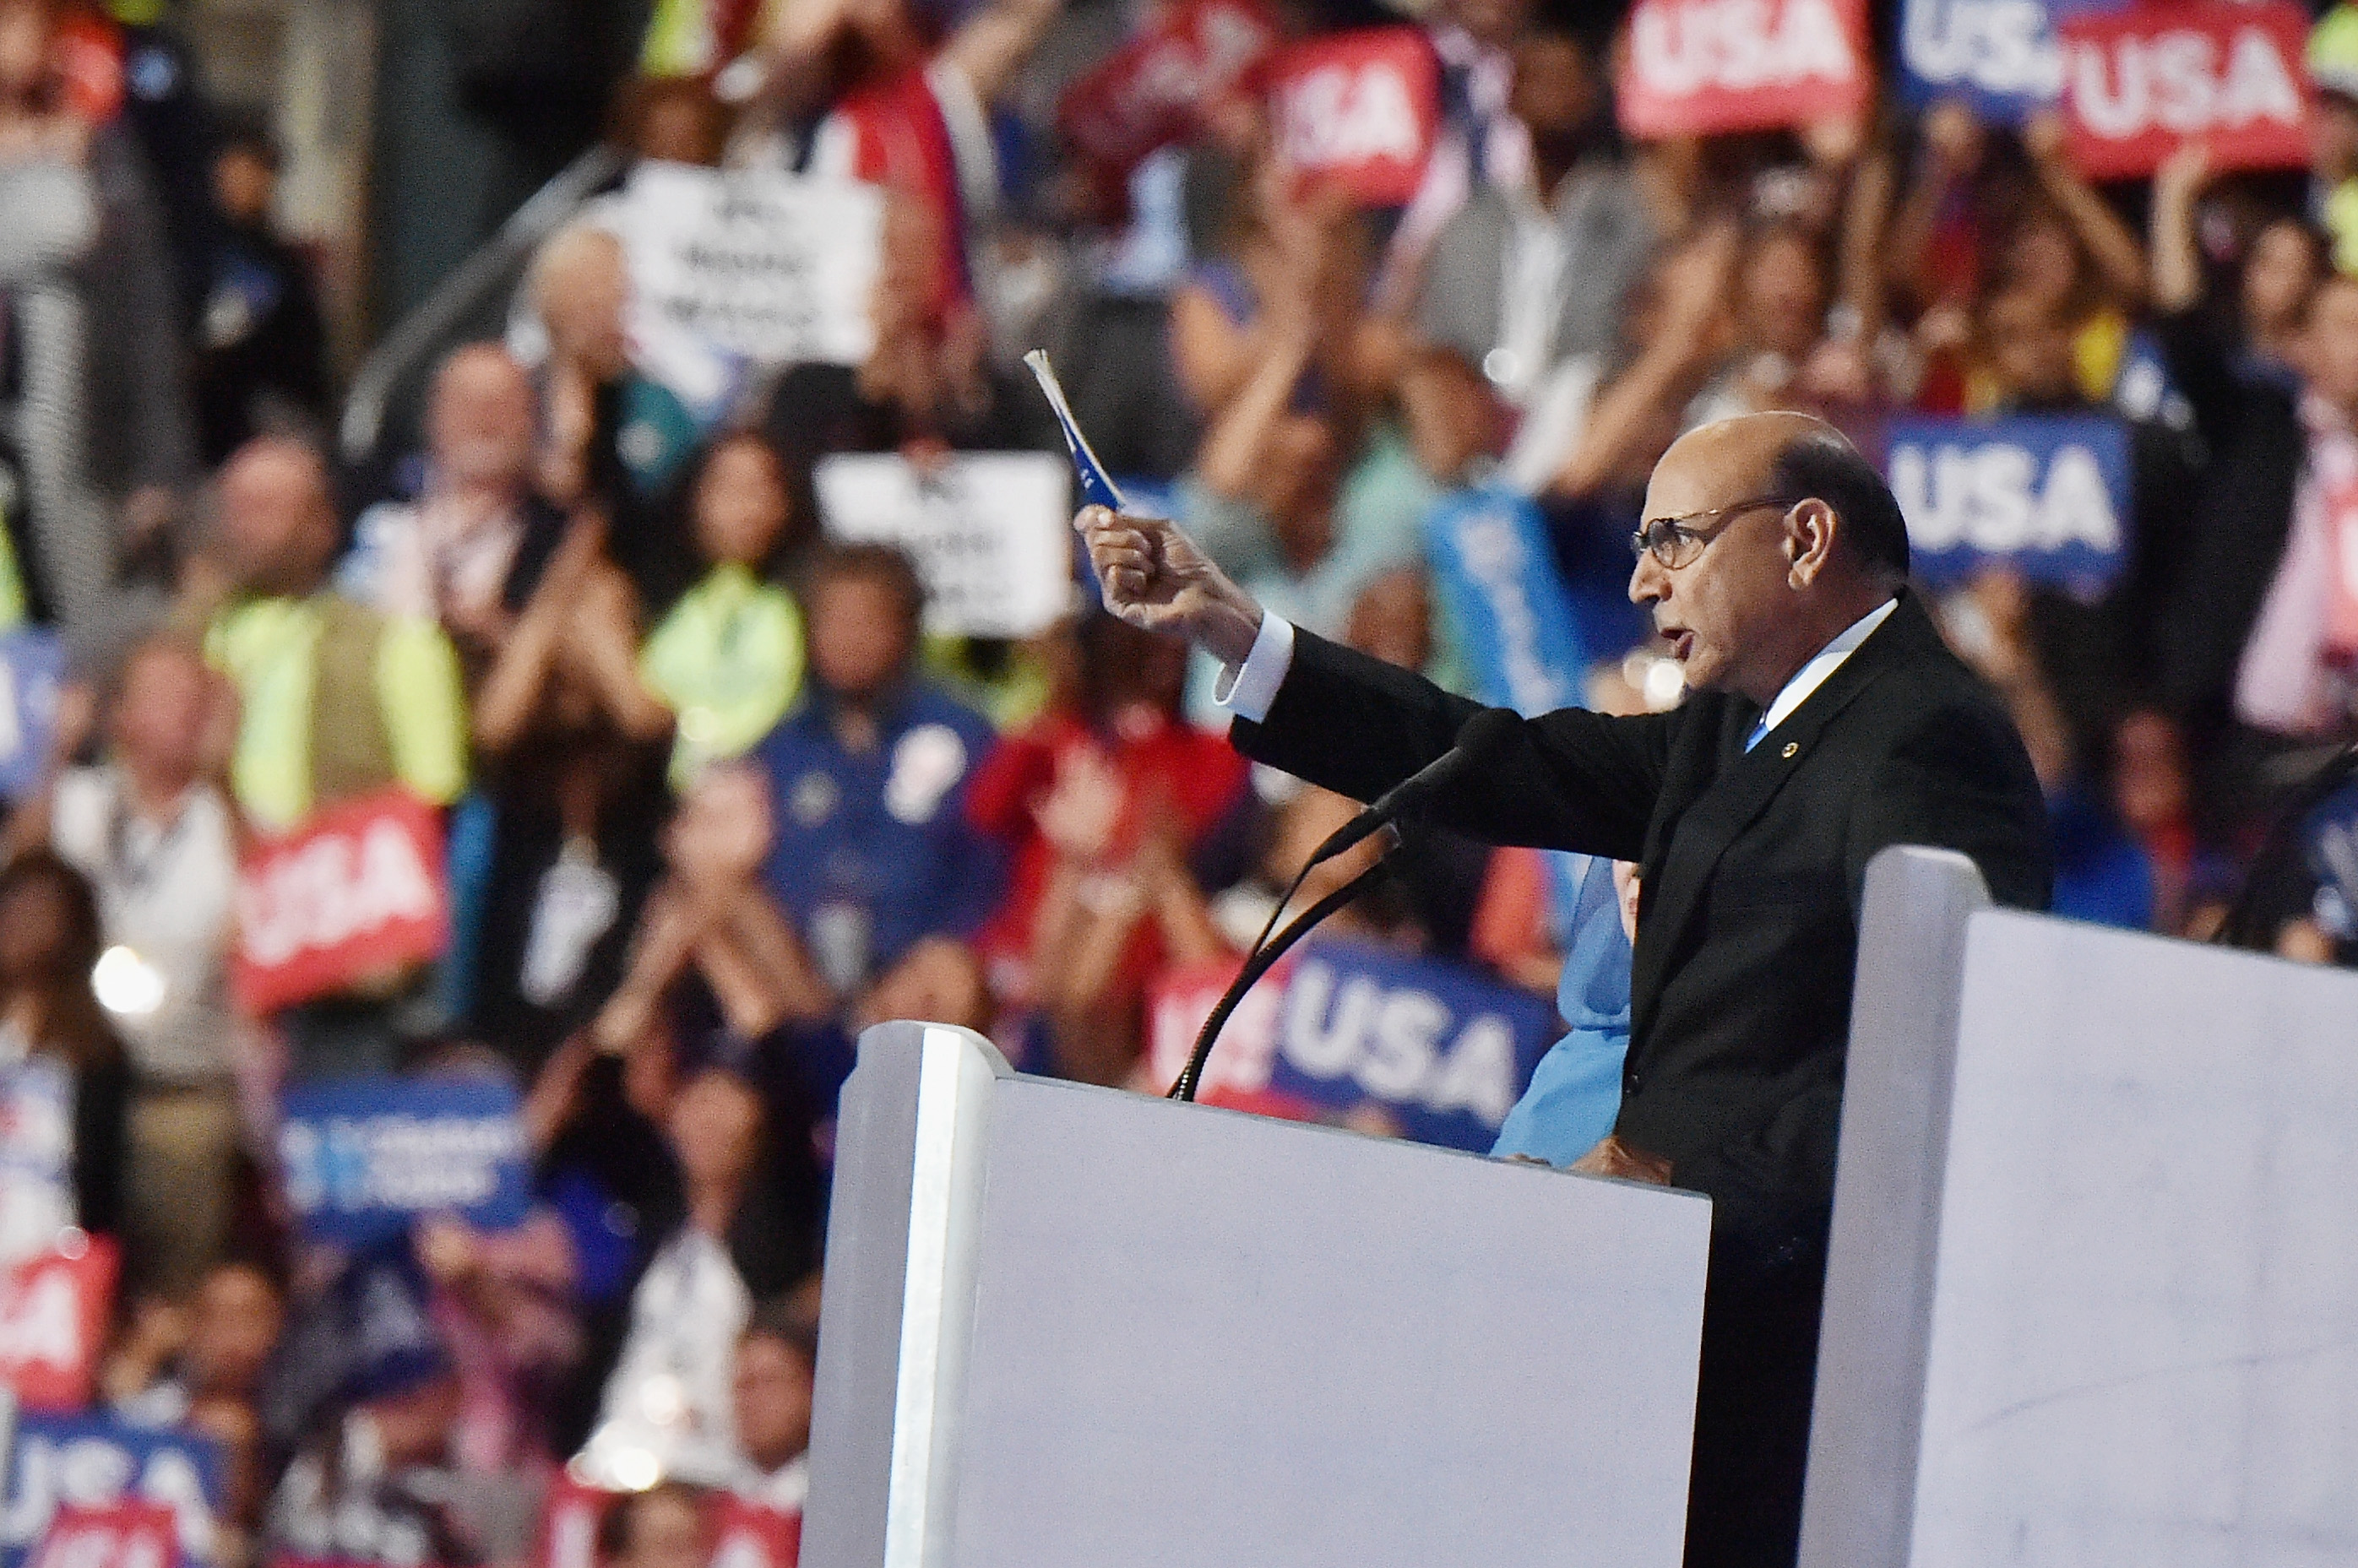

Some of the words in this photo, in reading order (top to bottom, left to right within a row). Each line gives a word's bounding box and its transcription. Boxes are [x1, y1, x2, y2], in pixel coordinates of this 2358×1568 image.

[2074, 29, 2304, 140] USA
[1890, 442, 2120, 553] USA
[240, 815, 436, 968] USA
[1282, 956, 1519, 1130] USA
